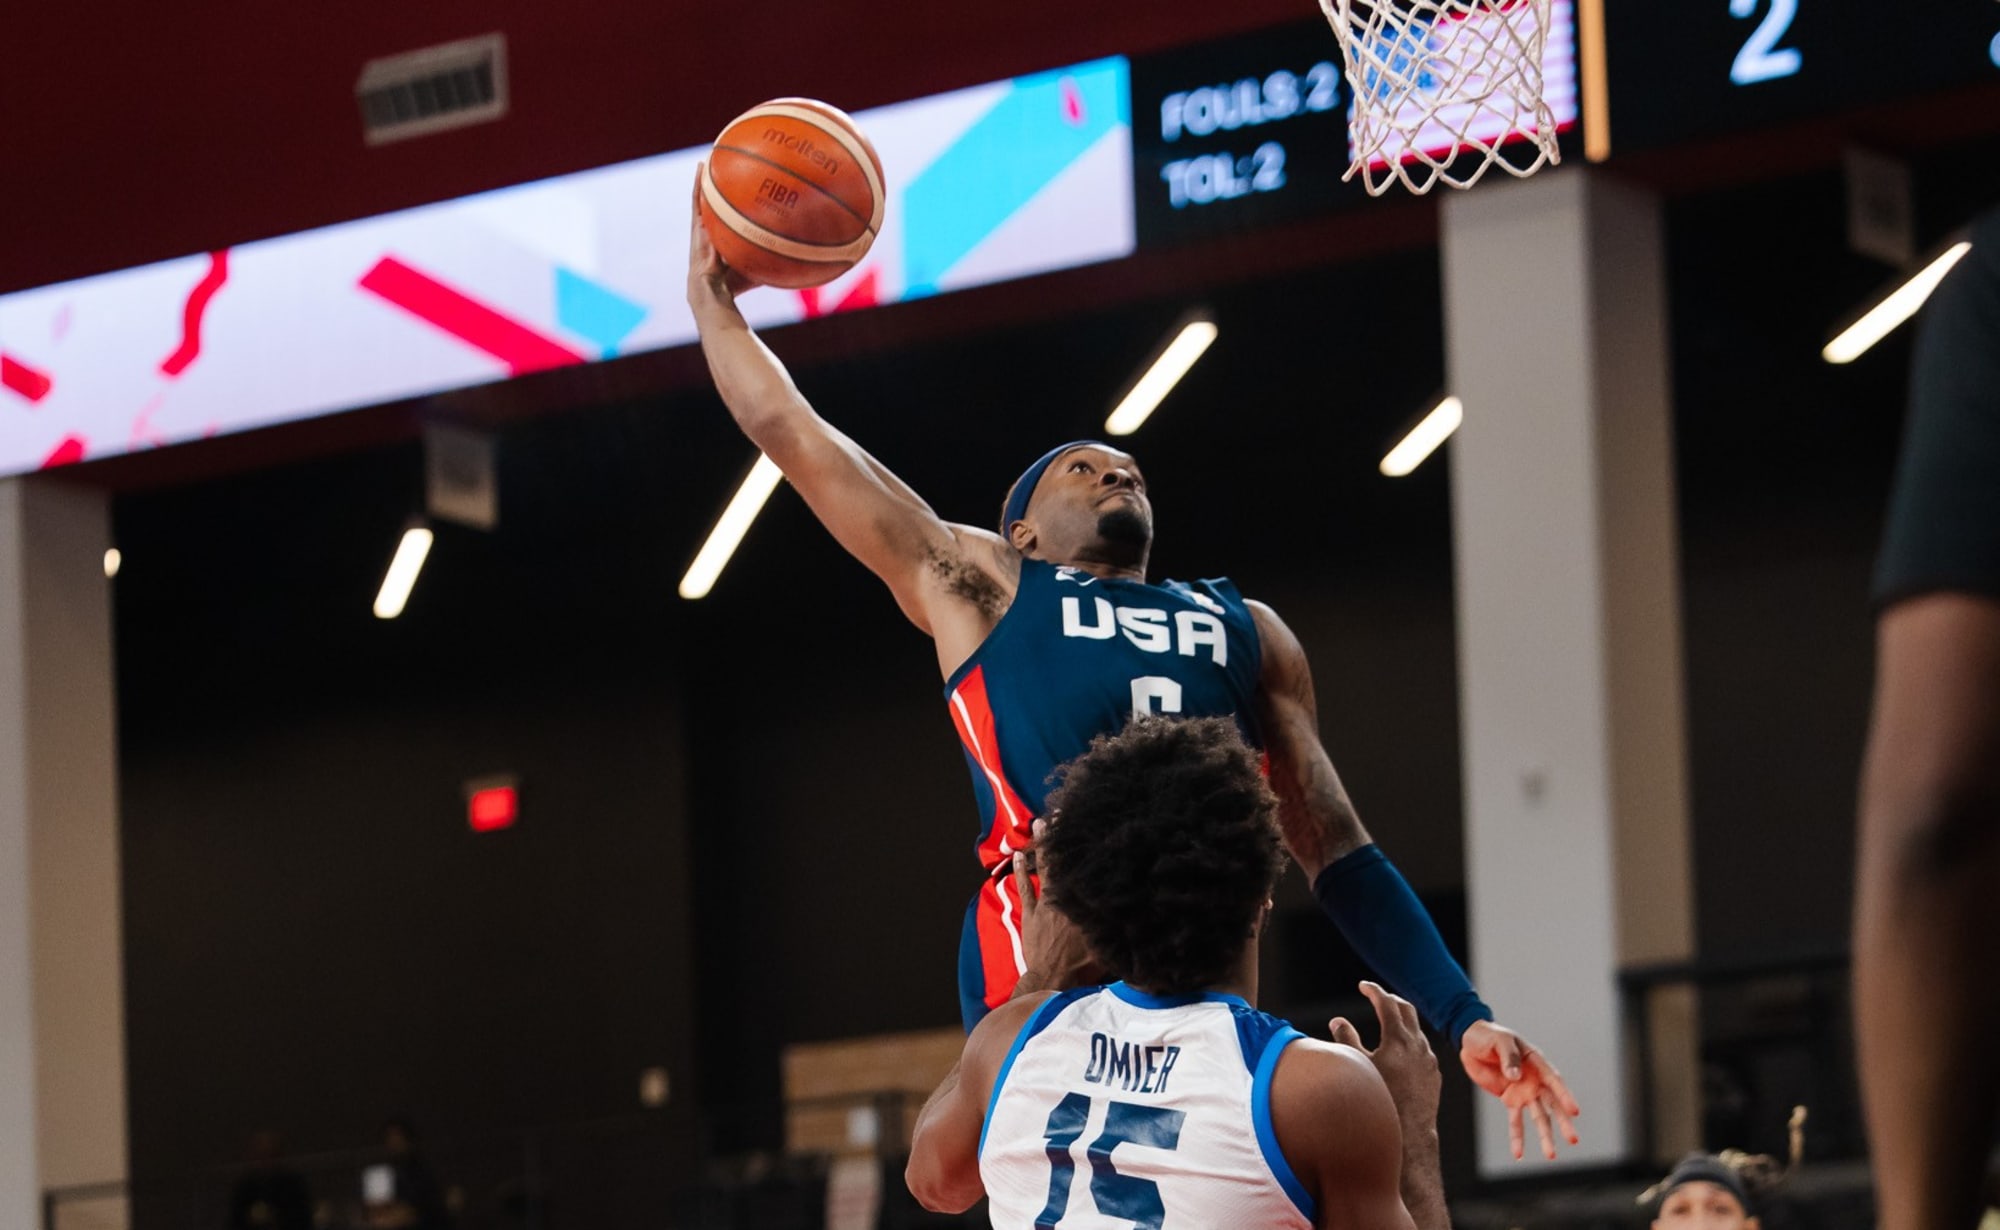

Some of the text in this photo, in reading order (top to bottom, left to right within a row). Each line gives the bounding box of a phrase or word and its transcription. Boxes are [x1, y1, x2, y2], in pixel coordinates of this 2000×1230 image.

[1729, 0, 1801, 84] 2
[762, 127, 839, 175] molten
[758, 177, 799, 209] FIBA
[1061, 596, 1228, 668] USA
[1083, 1031, 1181, 1095] OMIER
[1033, 1091, 1187, 1230] 15
